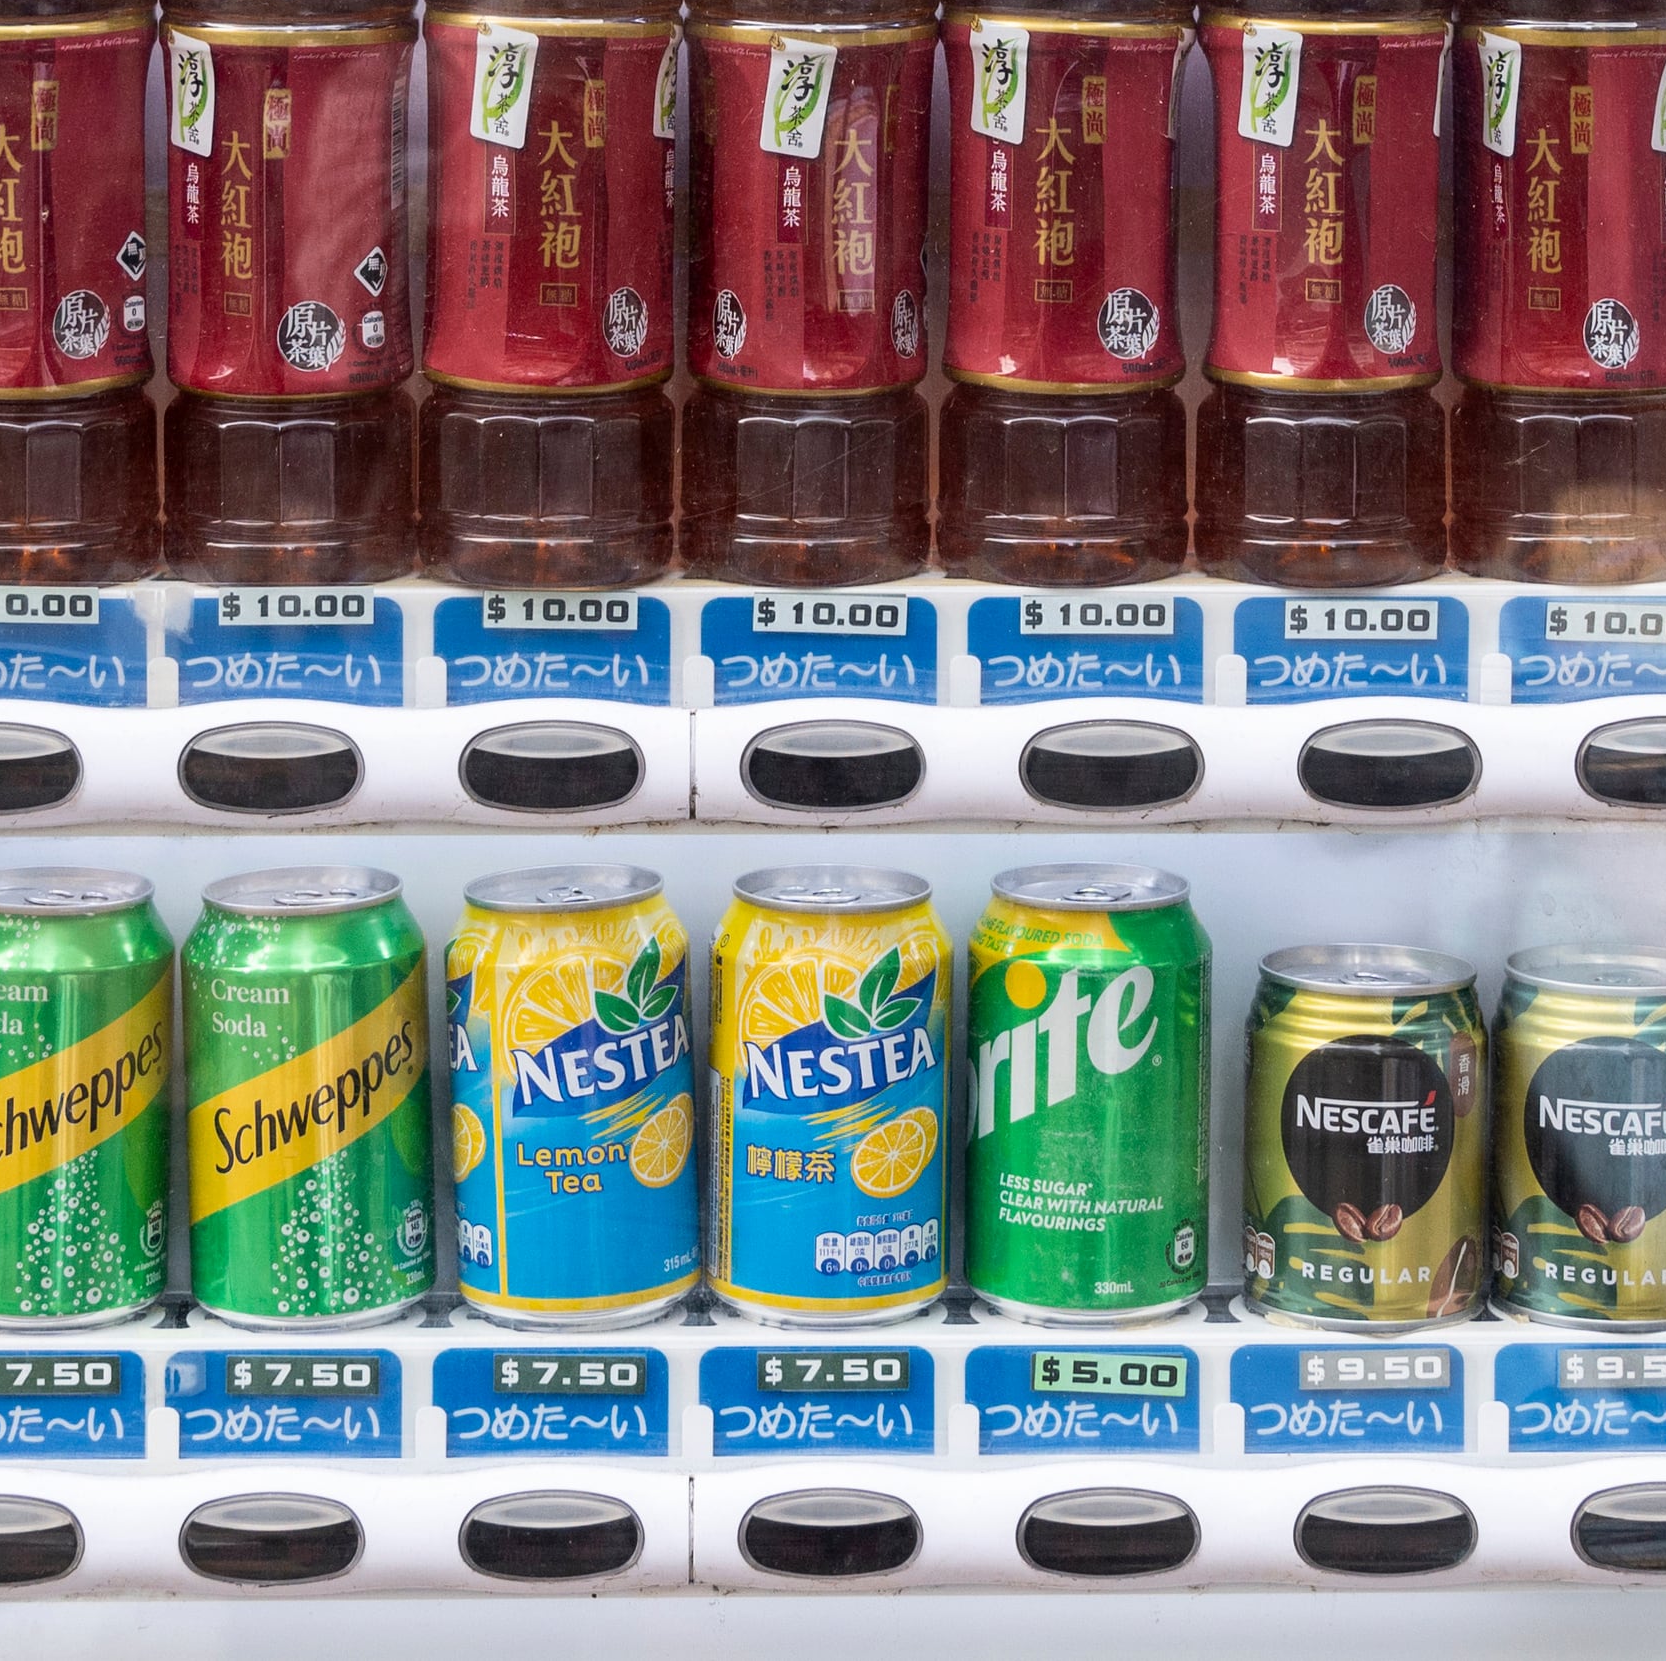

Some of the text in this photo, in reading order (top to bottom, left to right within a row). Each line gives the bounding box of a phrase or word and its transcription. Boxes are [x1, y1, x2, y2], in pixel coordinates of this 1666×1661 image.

[537, 120, 583, 270] 大紅袍
[1035, 118, 1076, 268] 大紅袍
[1304, 118, 1345, 266] 大紅袍
[220, 131, 253, 282] 大紅袍
[211, 978, 290, 1004] Cream
[212, 1012, 267, 1038] Soda
[513, 1019, 691, 1106] NESTEA
[745, 1024, 936, 1101] NESTEA
[215, 1020, 413, 1174] Schweppes
[517, 1142, 626, 1166] Lemon
[1367, 1136, 1435, 1154] 雀巢咖啡
[746, 1143, 836, 1184] 檸檬茶
[545, 1170, 603, 1195] Tea
[1000, 1173, 1029, 1191] LESS
[1000, 1191, 1164, 1214] CLEAR WITH NATURAL
[999, 1209, 1106, 1232] FLAVOURINGS
[1301, 1262, 1430, 1285] REGULAR
[1094, 1281, 1134, 1294] 330mL
